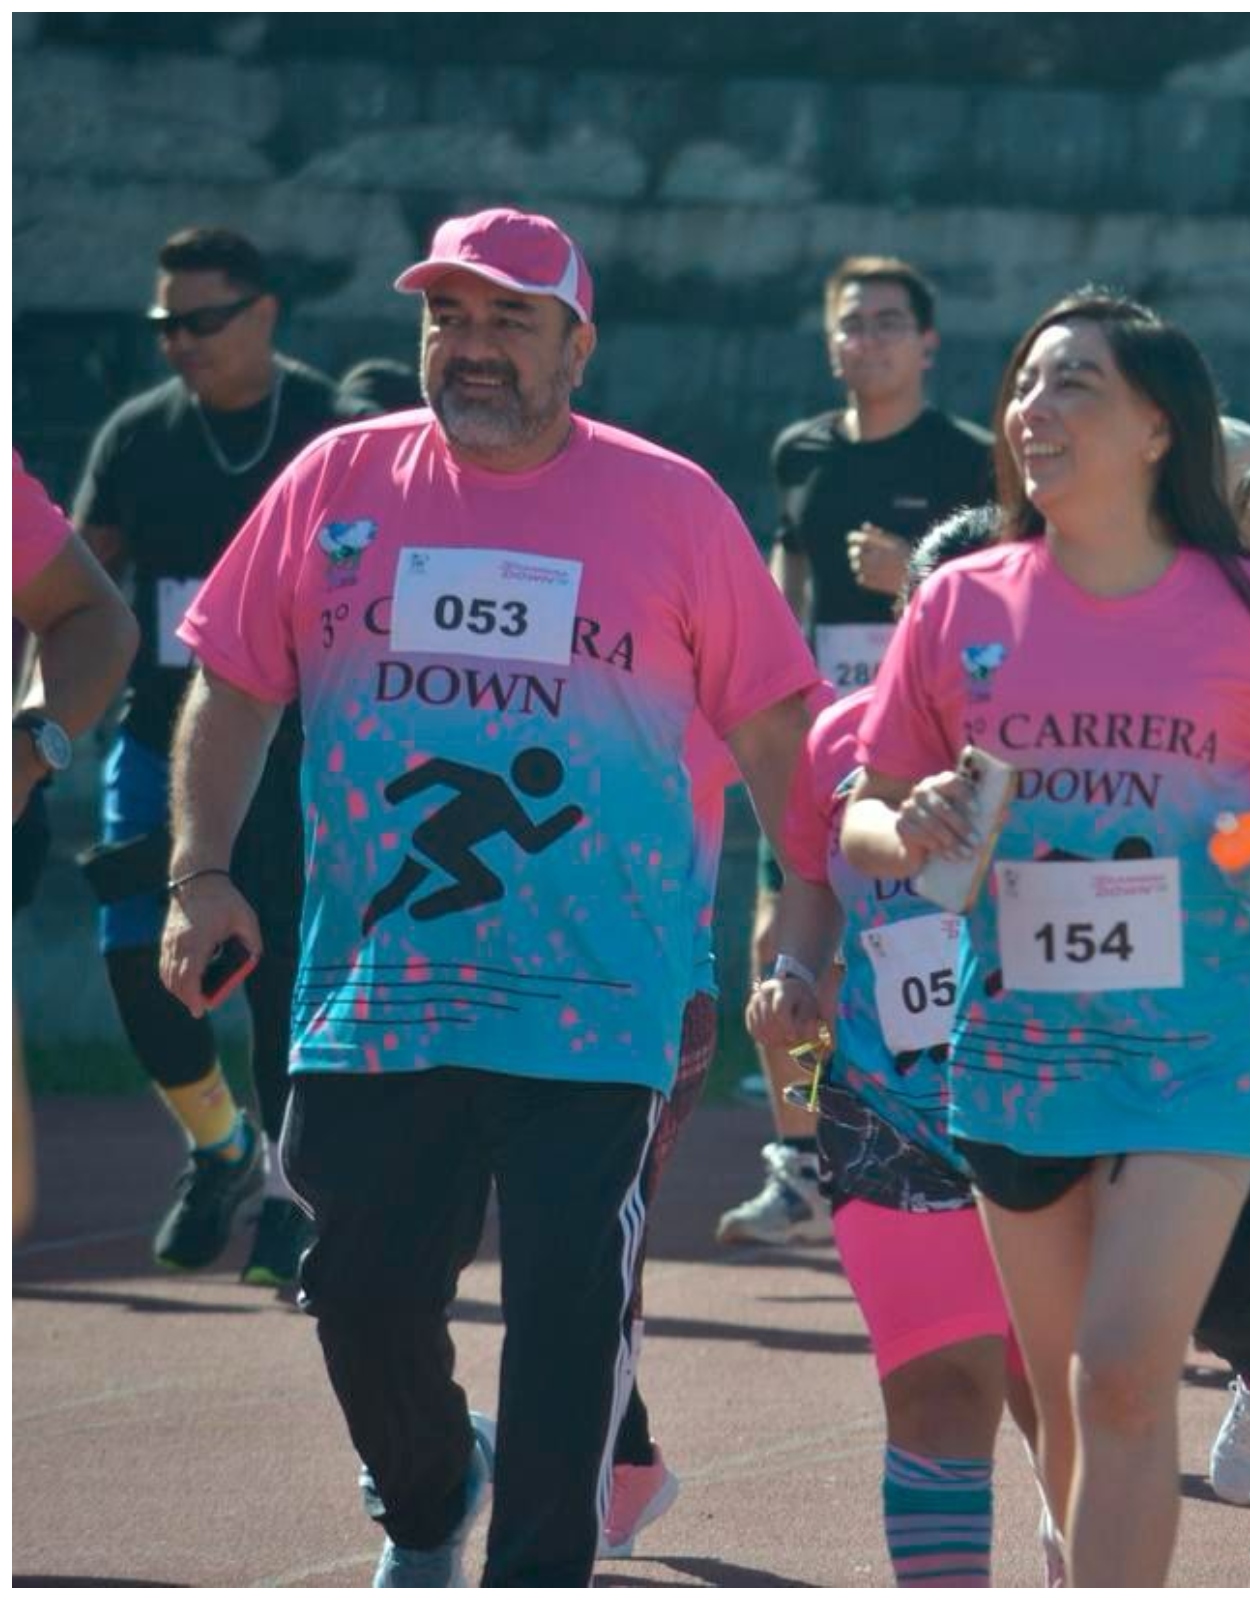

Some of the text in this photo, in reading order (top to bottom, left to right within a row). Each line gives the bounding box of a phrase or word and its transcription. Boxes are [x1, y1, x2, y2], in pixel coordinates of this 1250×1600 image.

[434, 594, 528, 637] 053
[375, 659, 567, 718] DOWN
[836, 660, 882, 687] 28
[997, 711, 1219, 765] CARRERA
[1014, 767, 1162, 810] DOWN
[1034, 920, 1134, 965] 154
